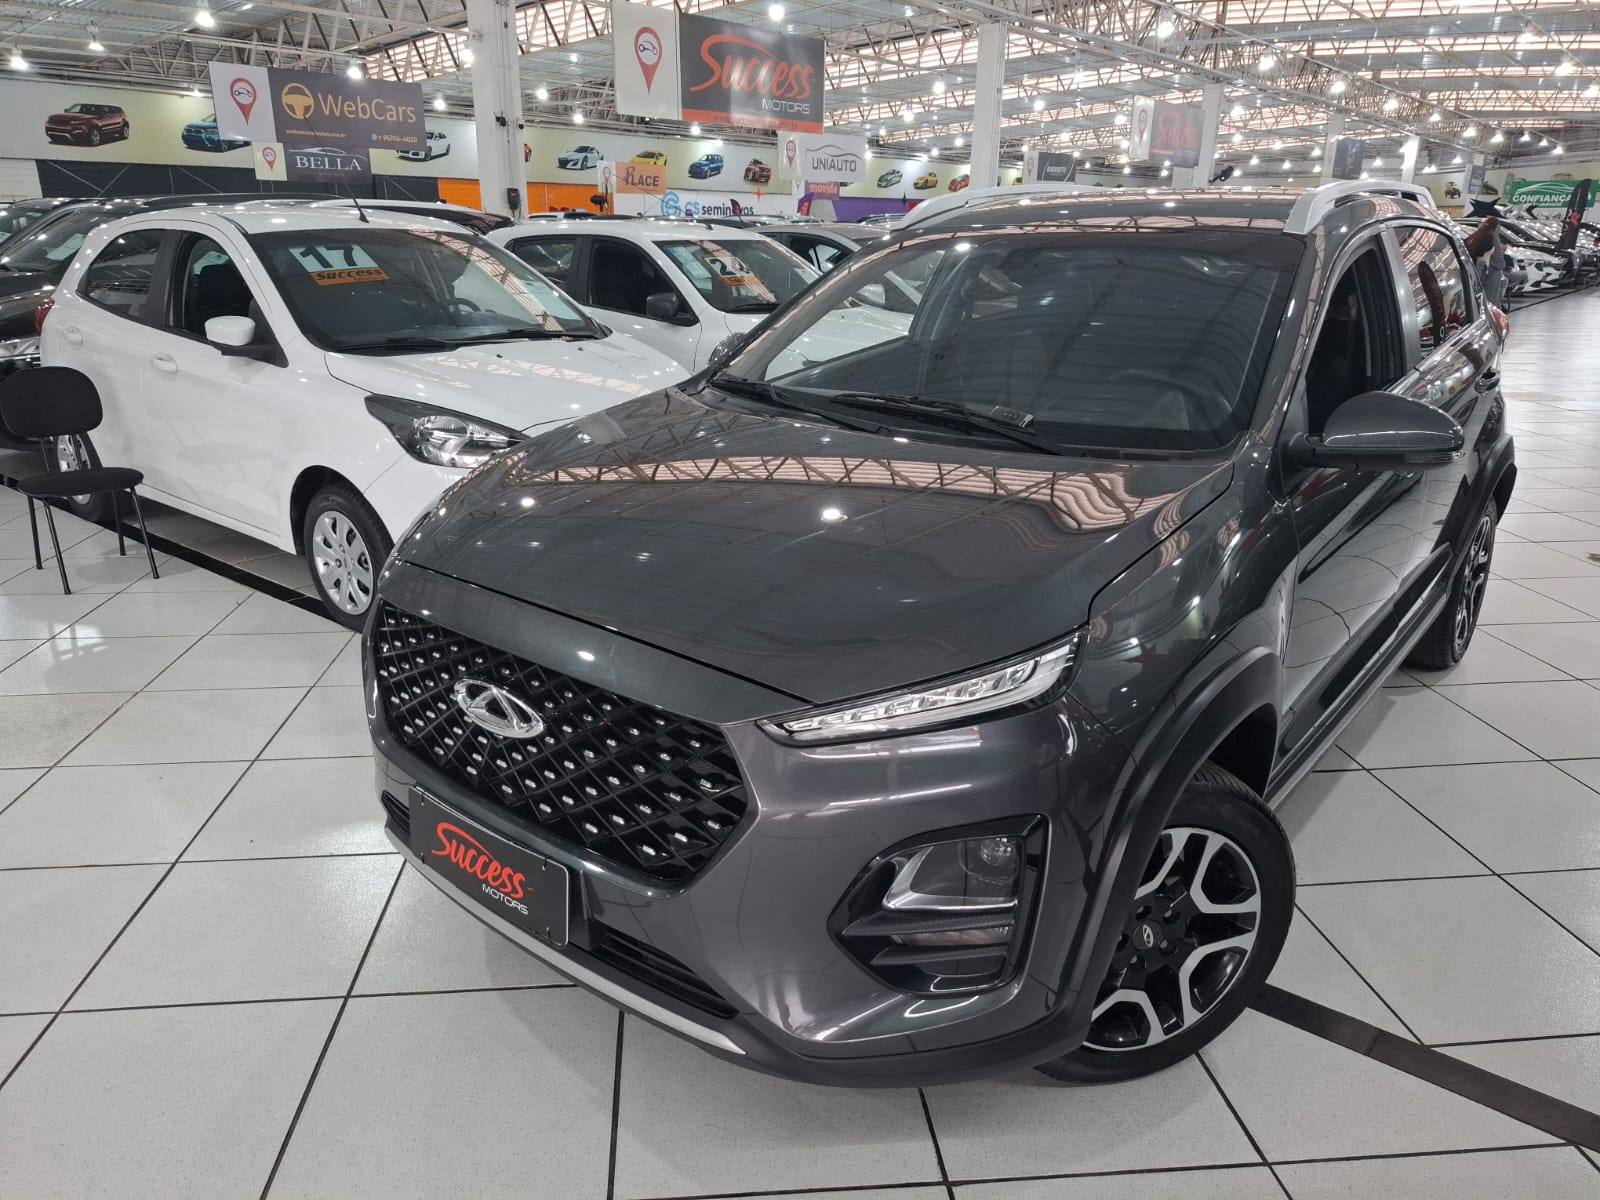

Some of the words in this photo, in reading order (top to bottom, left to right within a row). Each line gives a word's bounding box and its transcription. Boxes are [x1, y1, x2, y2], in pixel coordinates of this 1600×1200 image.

[688, 34, 815, 99] Success
[318, 93, 416, 123] WebCars
[762, 98, 810, 115] MOTORS
[295, 155, 363, 171] BELLA
[812, 157, 857, 172] UNIAUTO
[810, 183, 838, 194] movida
[701, 202, 754, 216] seminos
[299, 246, 358, 269] 17
[432, 822, 526, 899] Success
[482, 883, 529, 915] MOTORS
